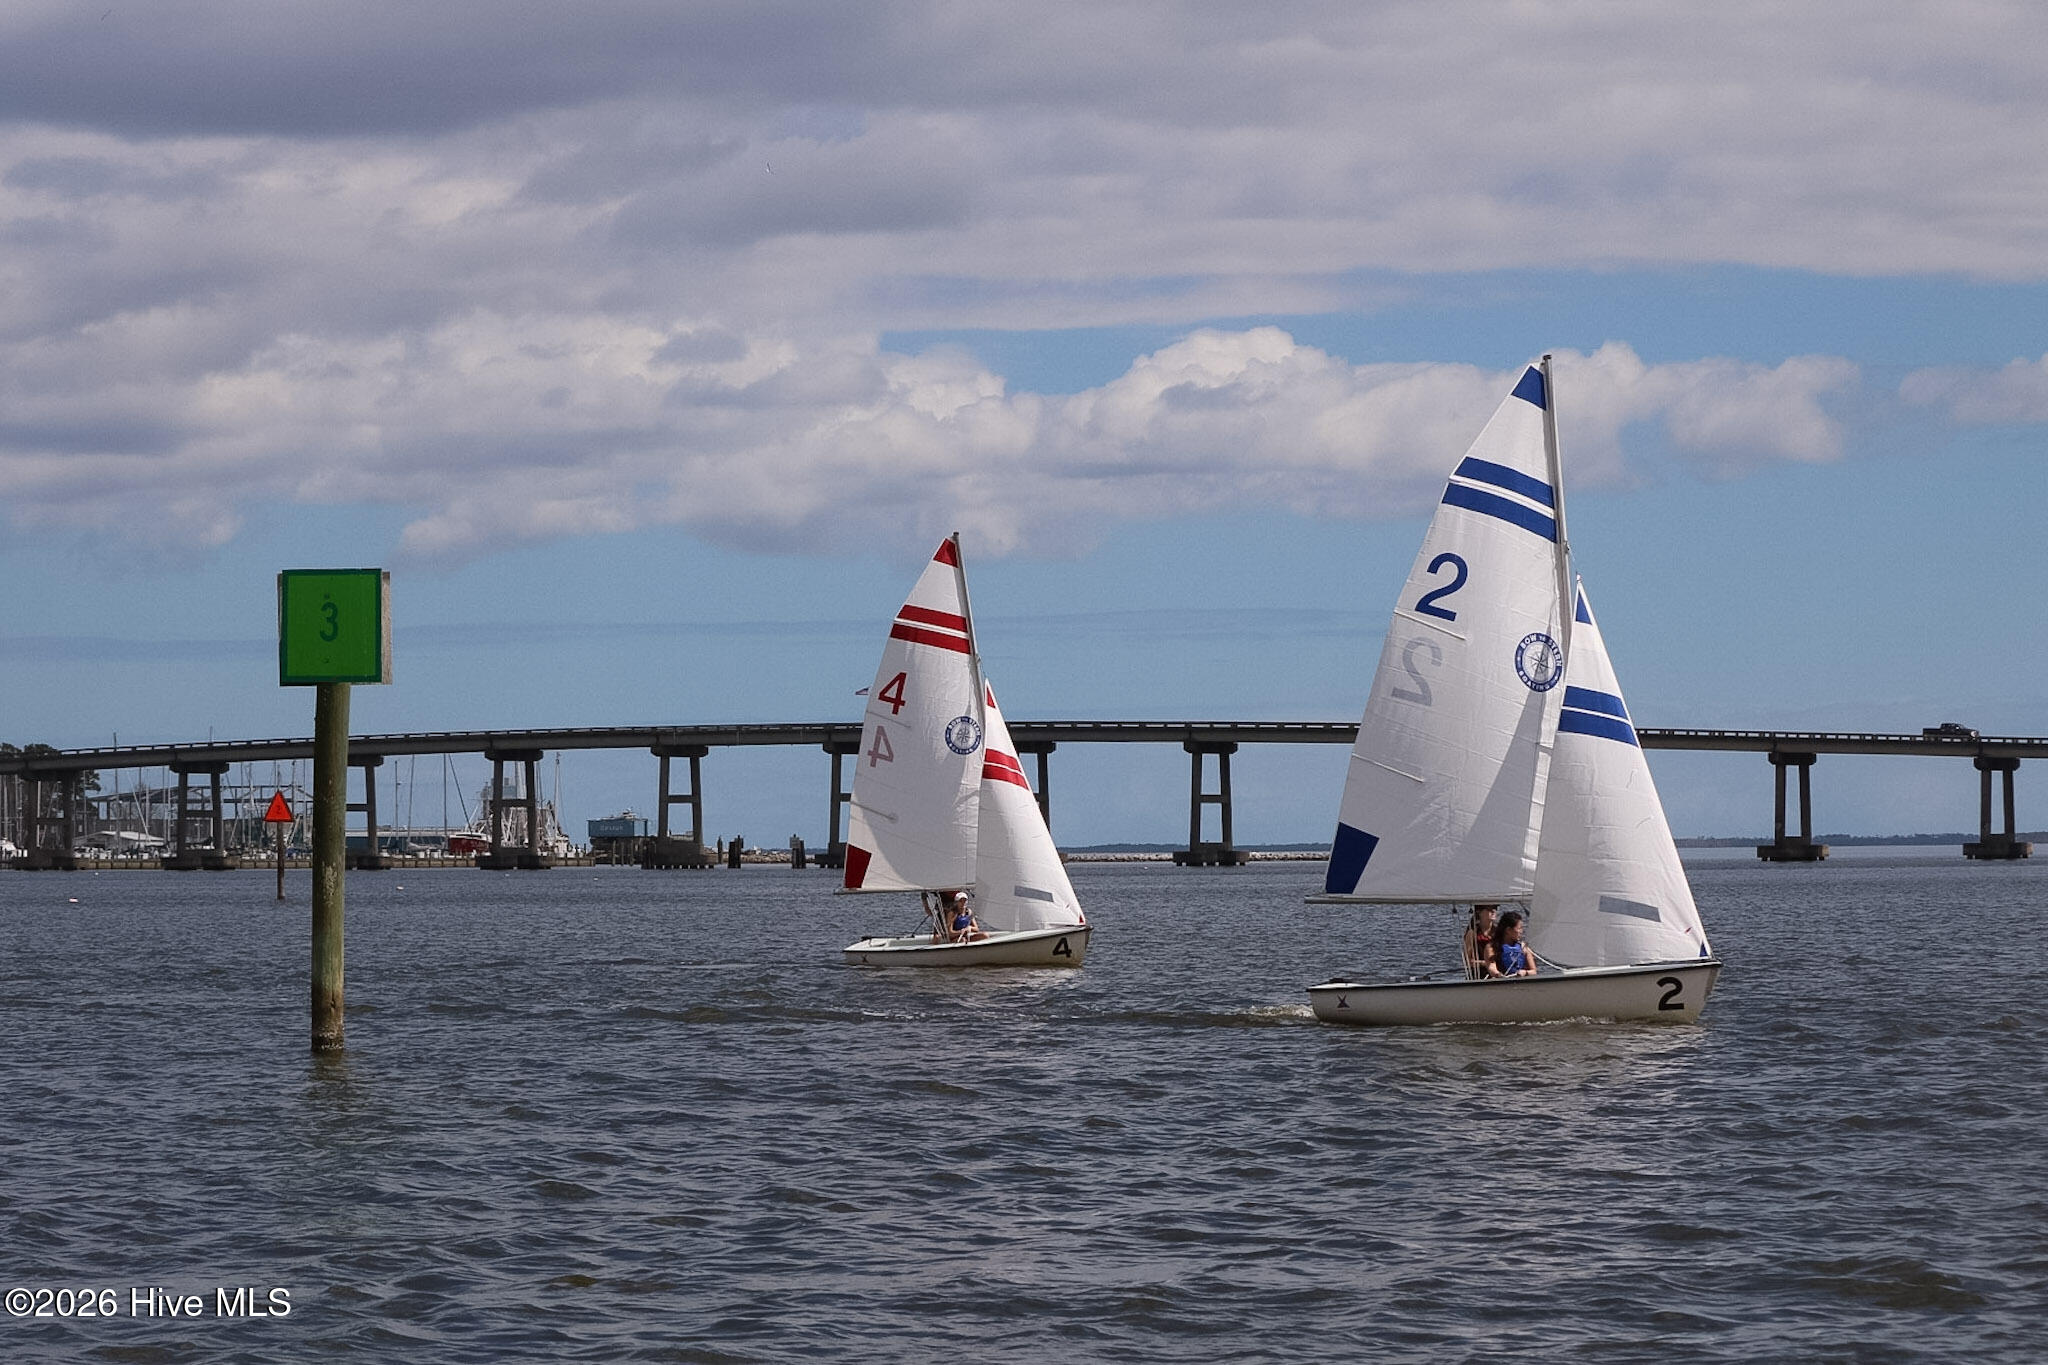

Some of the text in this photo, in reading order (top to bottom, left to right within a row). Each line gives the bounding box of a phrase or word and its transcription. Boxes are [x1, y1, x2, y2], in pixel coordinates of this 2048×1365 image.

[1415, 553, 1468, 622] 2
[320, 602, 339, 642] 3
[1519, 634, 1537, 650] BOW
[878, 672, 907, 715] 4
[1052, 937, 1073, 958] 4
[1656, 976, 1685, 1011] 2
